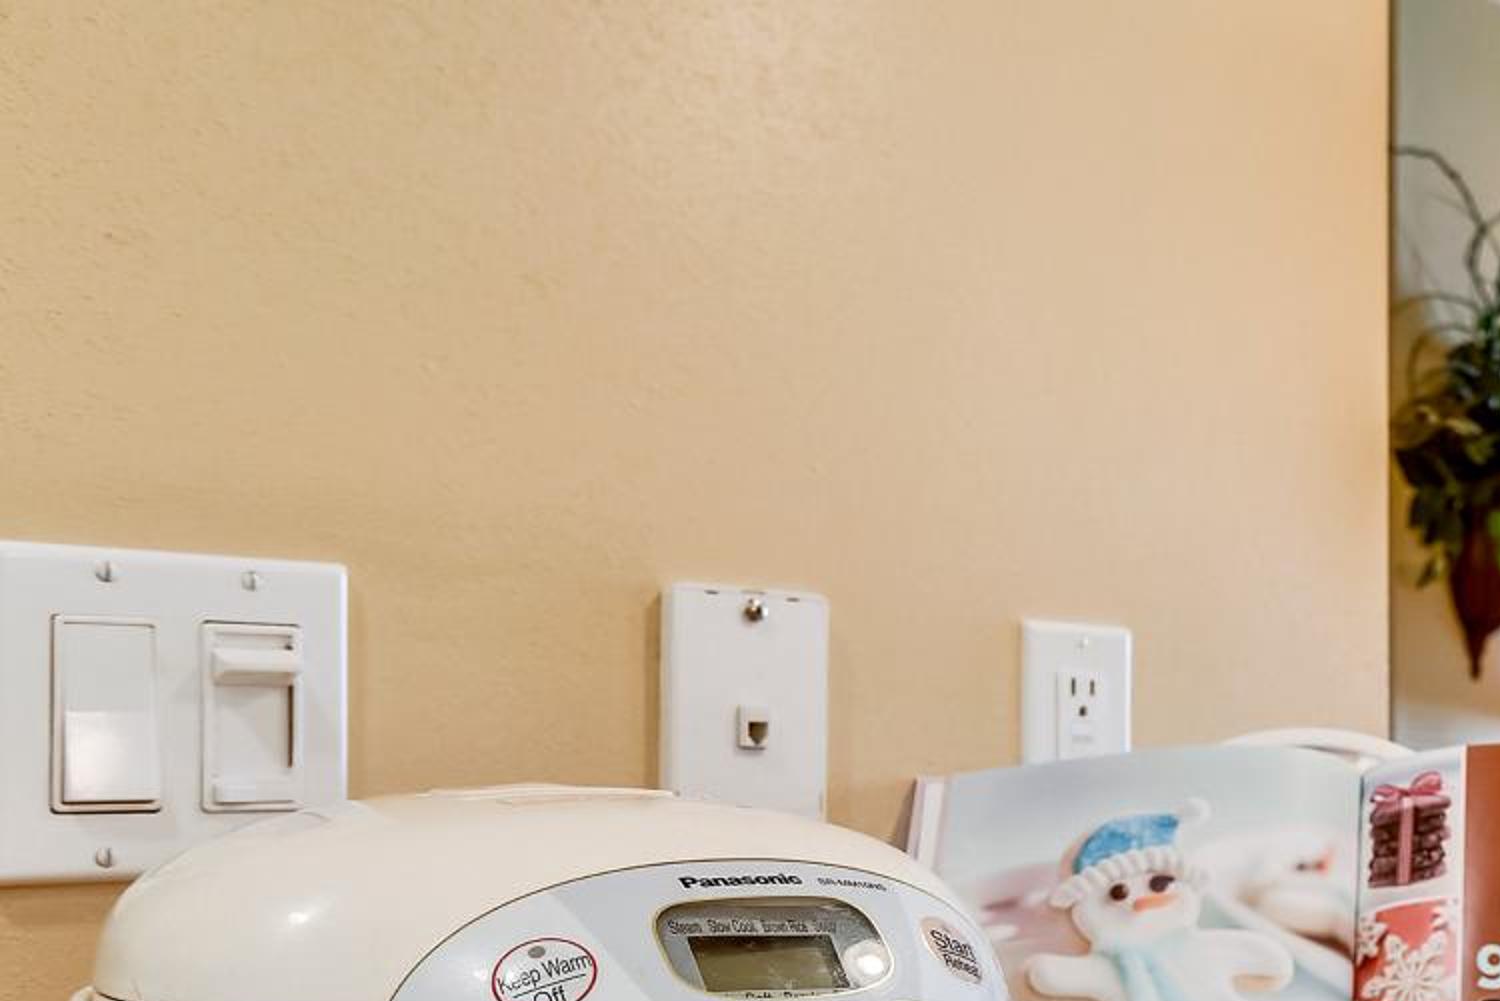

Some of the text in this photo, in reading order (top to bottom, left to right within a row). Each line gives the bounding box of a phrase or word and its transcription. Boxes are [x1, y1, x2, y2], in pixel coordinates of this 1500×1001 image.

[678, 873, 803, 889] Panasonic
[496, 955, 593, 995] Keep Warm
